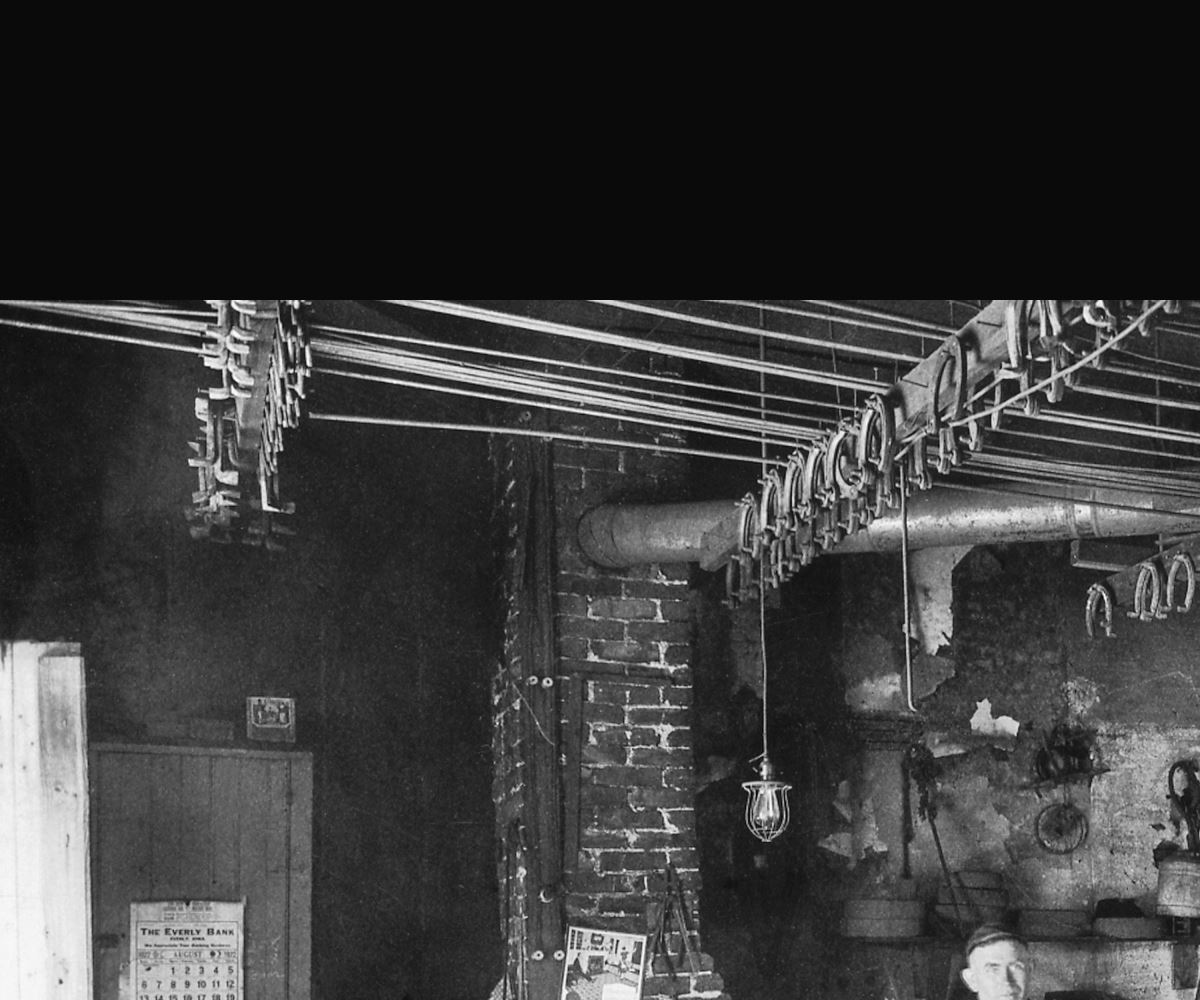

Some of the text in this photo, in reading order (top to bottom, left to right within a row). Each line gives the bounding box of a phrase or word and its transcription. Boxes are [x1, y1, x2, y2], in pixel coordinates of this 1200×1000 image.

[140, 928, 235, 936] THE EVERLY BANK
[171, 966, 234, 975] 1 2 3 4 5
[141, 979, 235, 989] 6 7 8 9 10 11 12
